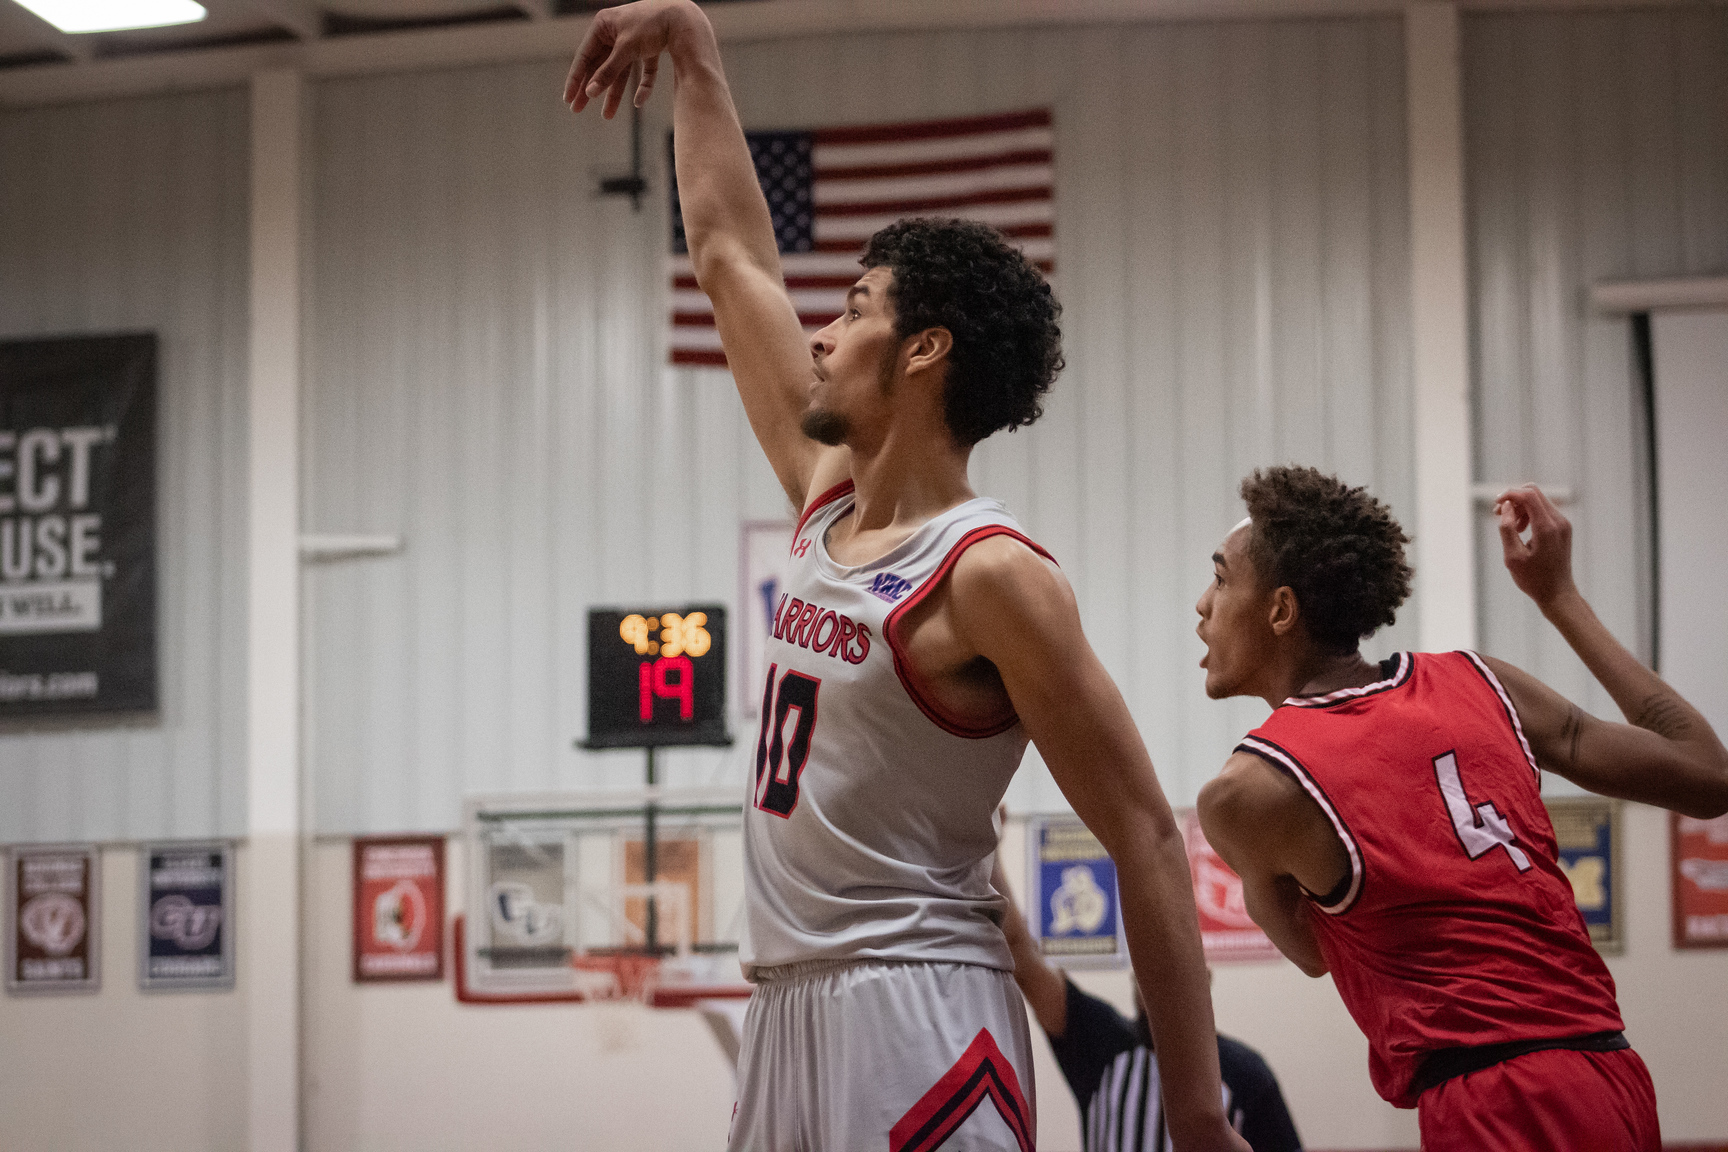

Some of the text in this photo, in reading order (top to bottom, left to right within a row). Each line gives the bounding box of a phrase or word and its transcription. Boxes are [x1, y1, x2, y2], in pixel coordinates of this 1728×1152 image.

[1, 515, 116, 578] USE.
[620, 612, 711, 658] 9:36
[774, 593, 872, 664] ARRIORS
[639, 655, 694, 723] 19
[754, 662, 822, 820] 10
[1431, 748, 1533, 875] 4
